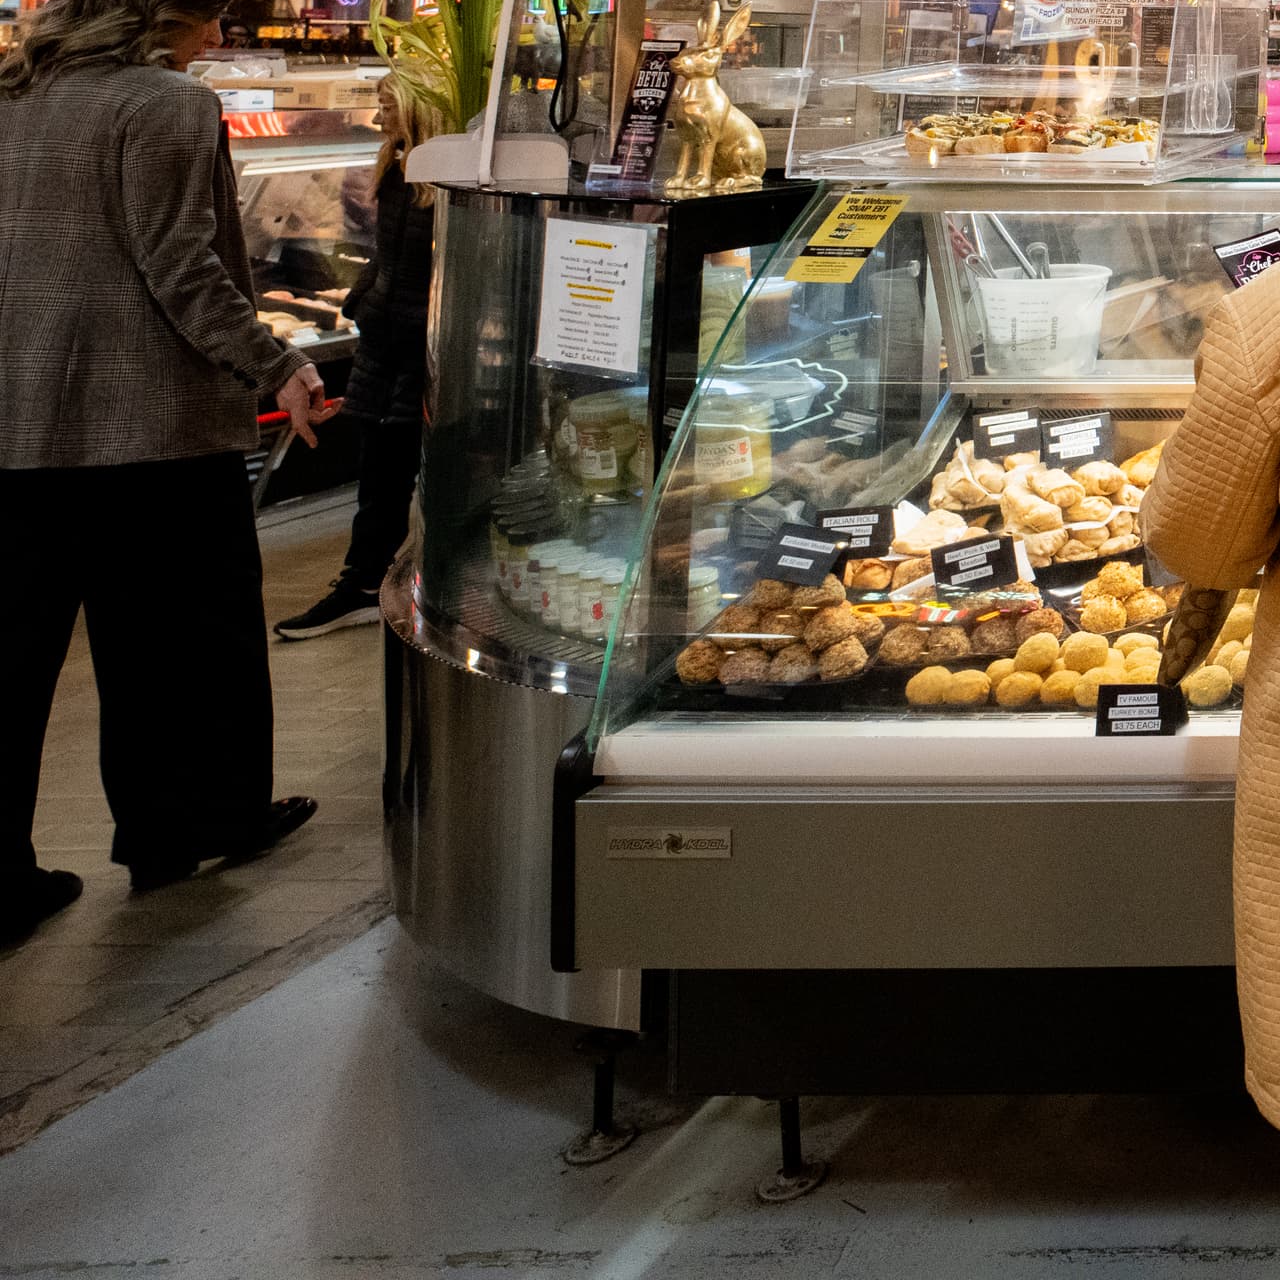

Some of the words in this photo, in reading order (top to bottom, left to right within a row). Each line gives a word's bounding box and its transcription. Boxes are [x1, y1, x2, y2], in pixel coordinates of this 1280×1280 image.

[837, 213, 887, 221] Customers
[1247, 256, 1272, 272] Chef
[825, 517, 855, 527] ITALIAN
[856, 516, 877, 524] ROLL
[1129, 695, 1156, 703] FAMOUS
[1137, 721, 1159, 729] EACH
[610, 839, 662, 850] HYDRA
[686, 839, 729, 850] KOOL
